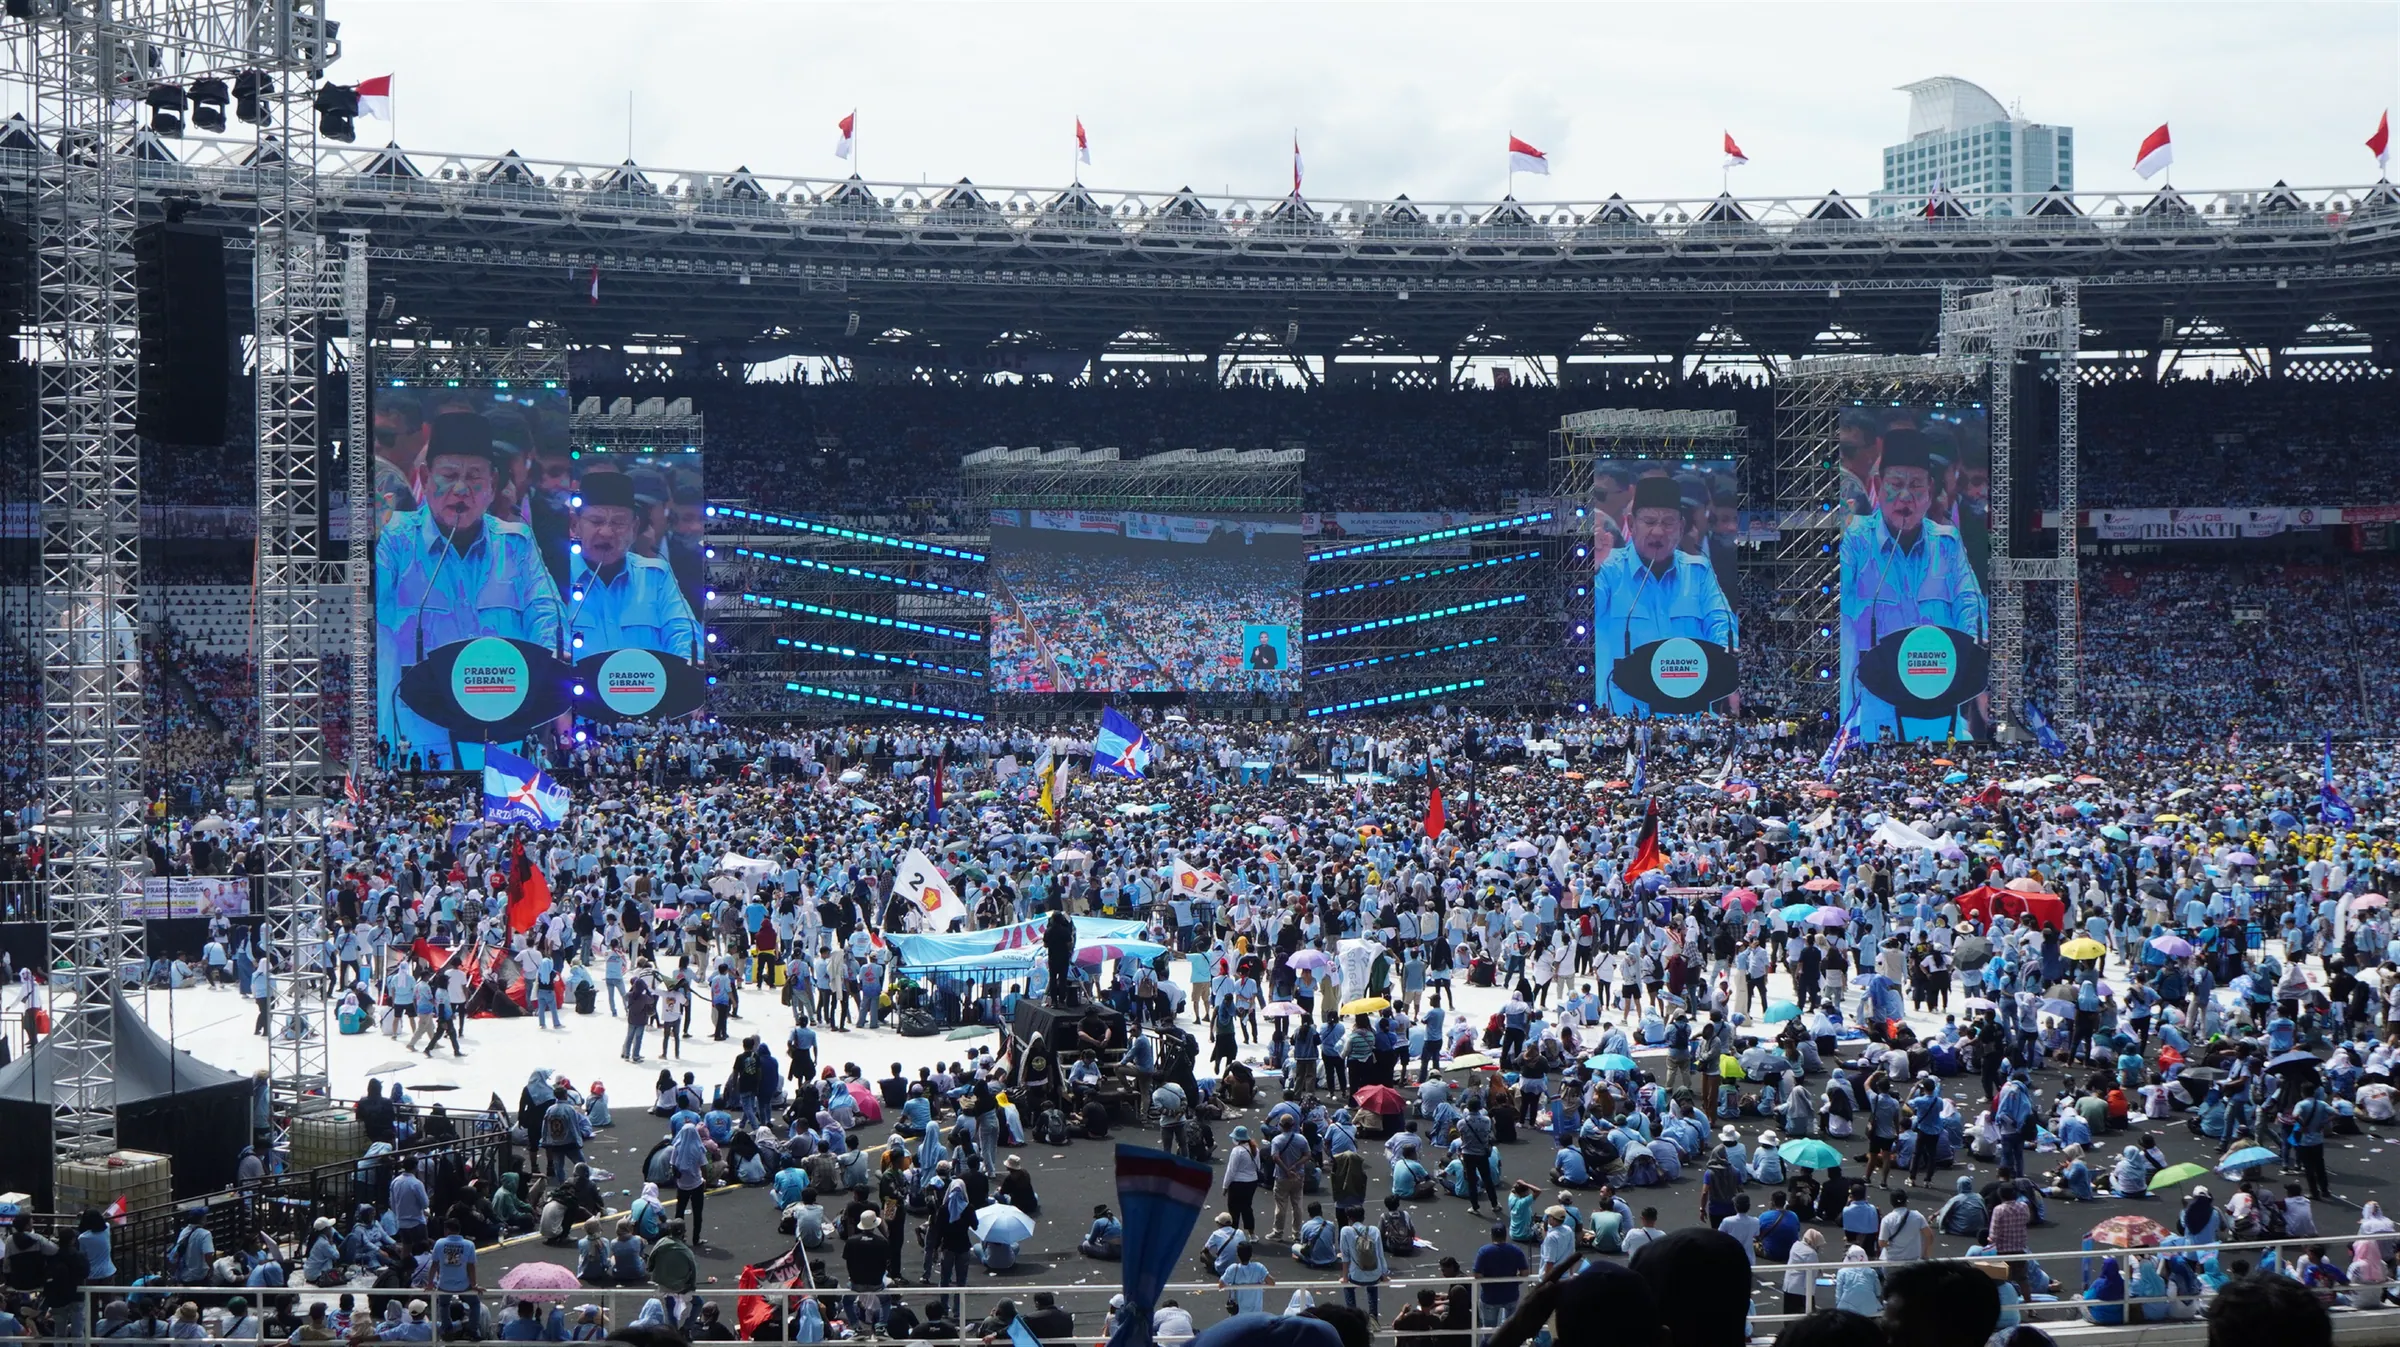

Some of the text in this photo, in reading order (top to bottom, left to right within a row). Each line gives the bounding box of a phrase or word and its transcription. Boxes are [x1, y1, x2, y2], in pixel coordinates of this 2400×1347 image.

[1079, 514, 1112, 523] GIBRAN
[2143, 522, 2235, 538] TRISAKTI
[1907, 651, 1947, 659] PRABOWO
[464, 666, 516, 676] PRABOWO
[464, 676, 504, 685] GIBRAN
[608, 679, 645, 687] GIBRAN
[908, 872, 925, 892] 2
[1200, 877, 1214, 893] 2
[2155, 1088, 2166, 1099] 2
